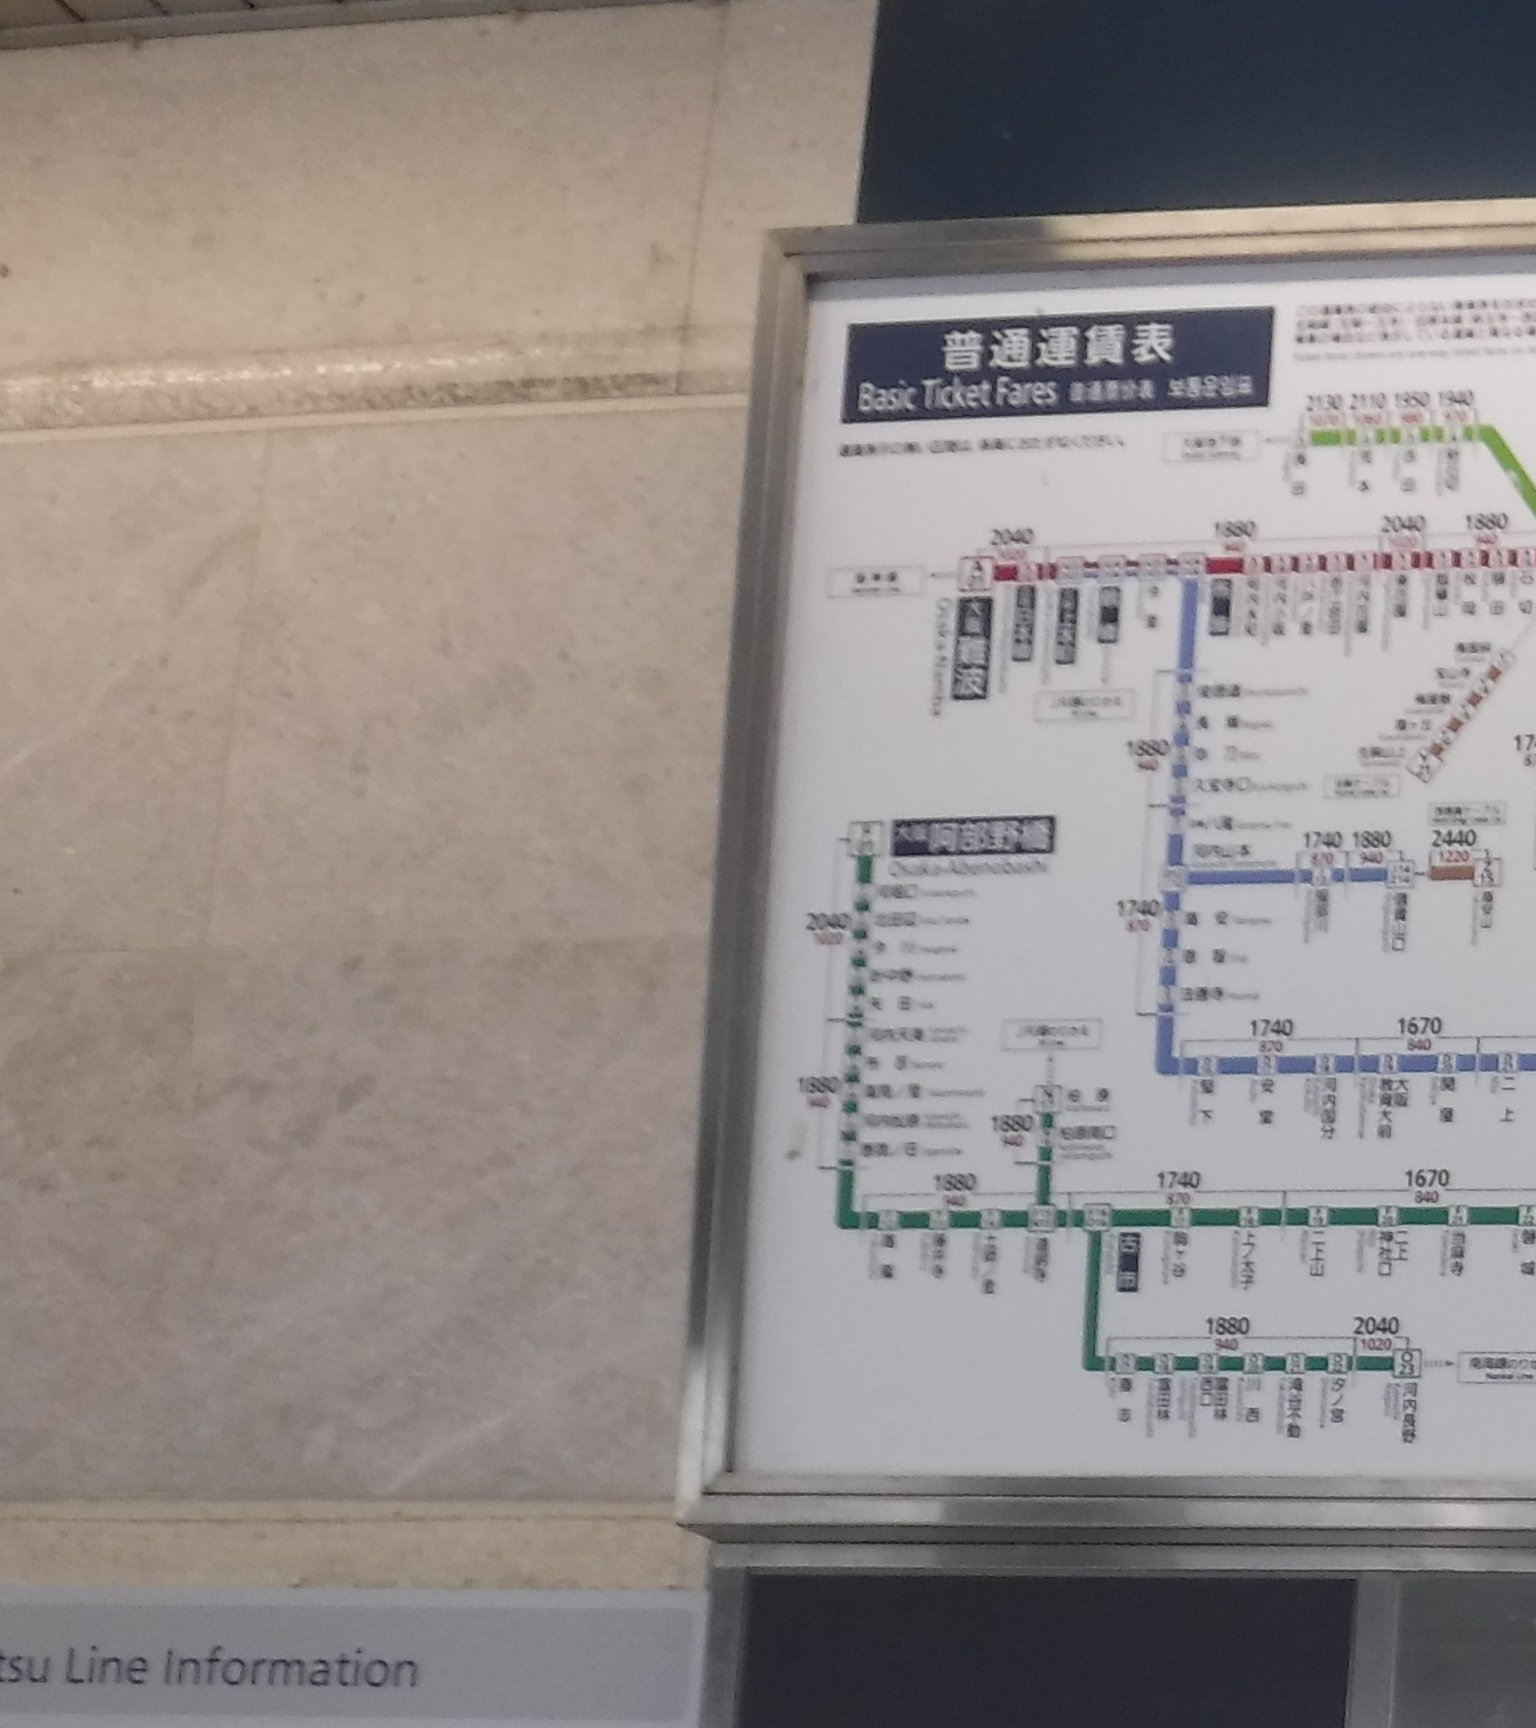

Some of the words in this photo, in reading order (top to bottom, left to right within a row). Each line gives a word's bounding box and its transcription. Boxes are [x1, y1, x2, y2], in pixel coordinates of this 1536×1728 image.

[943, 323, 1174, 371] 普通運賃表
[857, 379, 916, 413] Basic
[921, 376, 992, 410] Ticket
[995, 374, 1060, 406] Fares
[1432, 829, 1477, 847] 2440
[66, 1646, 149, 1685] Line
[165, 1646, 417, 1687] Information
